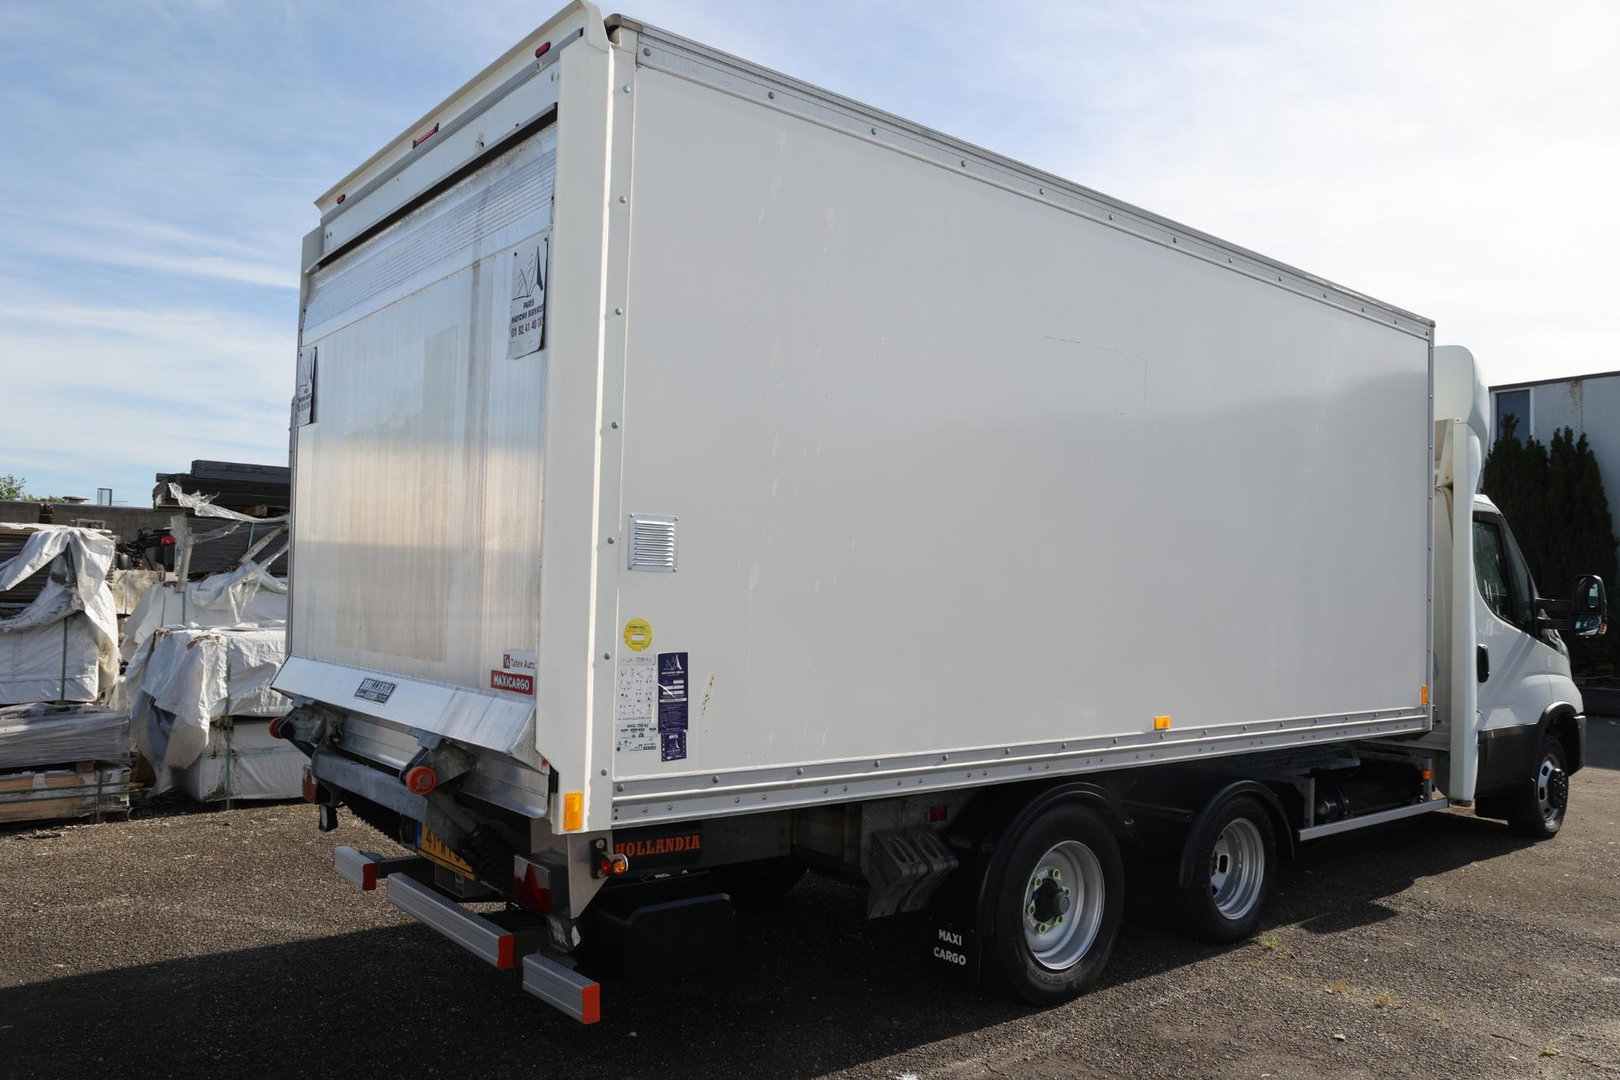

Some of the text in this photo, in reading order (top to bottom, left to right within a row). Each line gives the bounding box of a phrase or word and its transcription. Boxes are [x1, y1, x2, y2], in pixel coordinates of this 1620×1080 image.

[493, 673, 530, 691] MAXICARGO
[939, 928, 962, 946] MAXI
[933, 946, 967, 966] CARGO
